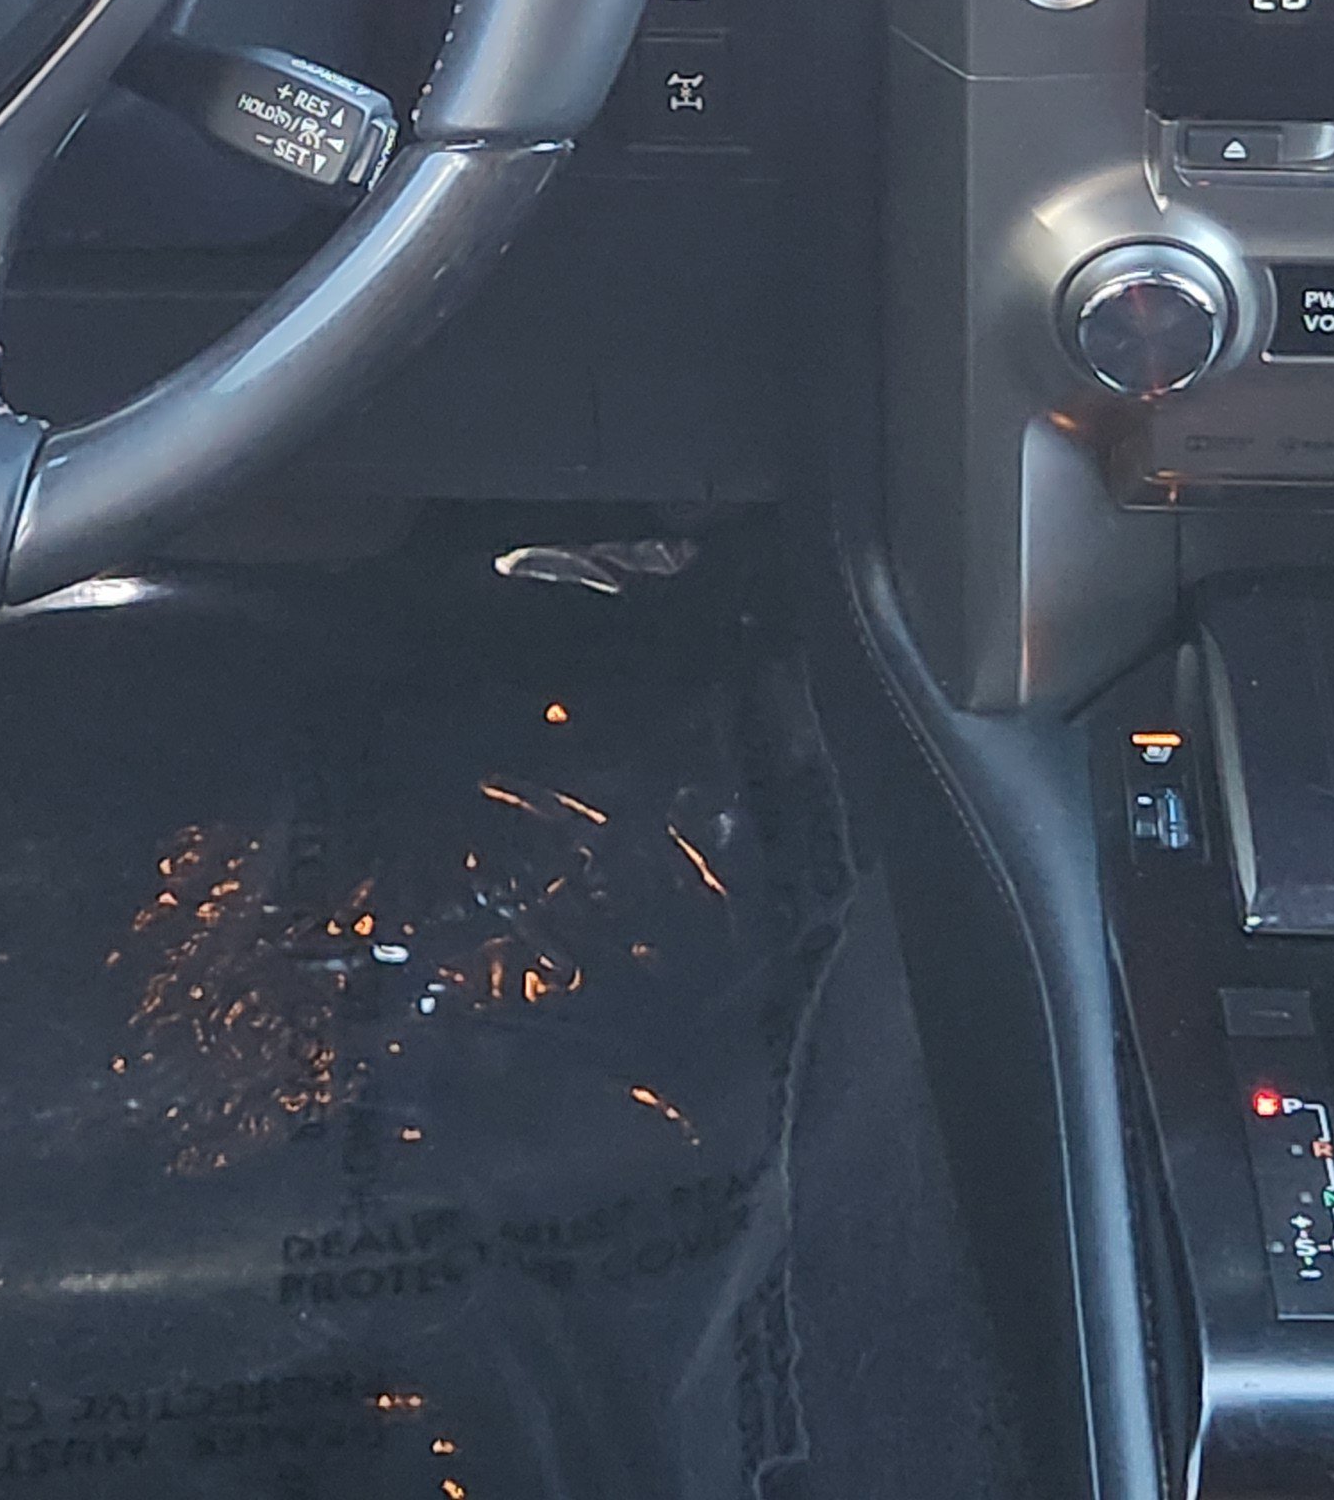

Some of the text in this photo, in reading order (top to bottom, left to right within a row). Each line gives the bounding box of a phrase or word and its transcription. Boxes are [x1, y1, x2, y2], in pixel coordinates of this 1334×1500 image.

[237, 92, 276, 122] HOLD
[293, 88, 331, 118] RES
[273, 136, 311, 168] SET
[1282, 1098, 1303, 1115] P
[1295, 1237, 1319, 1258] S
